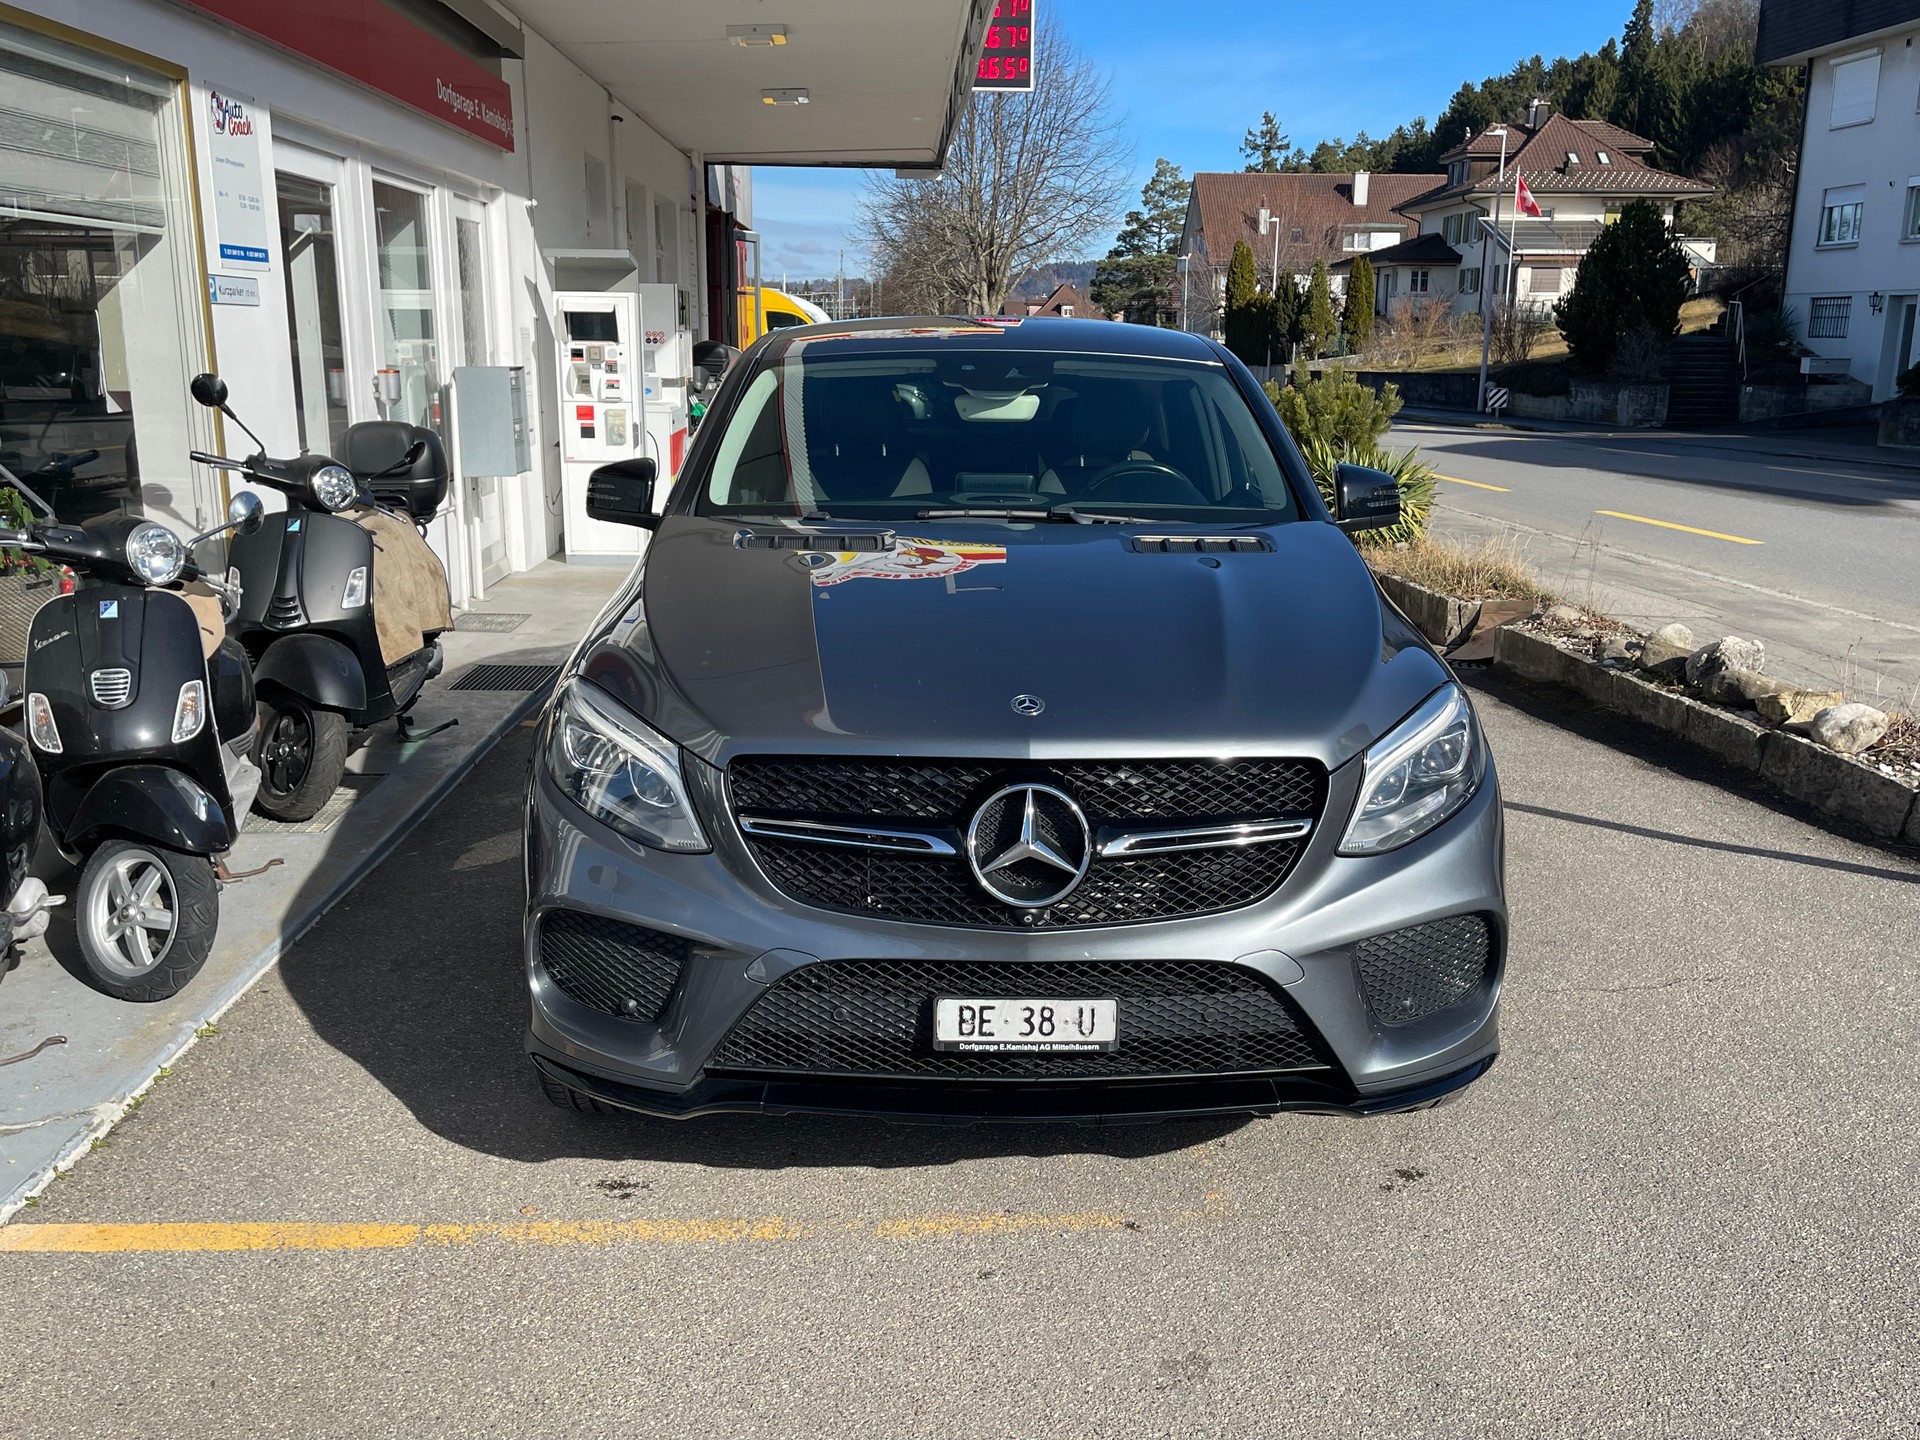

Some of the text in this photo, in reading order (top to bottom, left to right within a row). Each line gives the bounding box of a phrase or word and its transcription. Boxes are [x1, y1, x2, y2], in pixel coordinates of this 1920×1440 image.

[984, 26, 1029, 48] .670
[224, 99, 243, 119] Auto
[436, 77, 475, 120] Dorfgarage
[475, 98, 482, 119] E.
[481, 102, 509, 138] Kamishaj
[228, 115, 253, 136] Coach
[958, 1005, 1096, 1037] BE 38 U
[959, 1042, 1100, 1052] Dorfgarage E.Kamishaj AG Mittelhäusern
